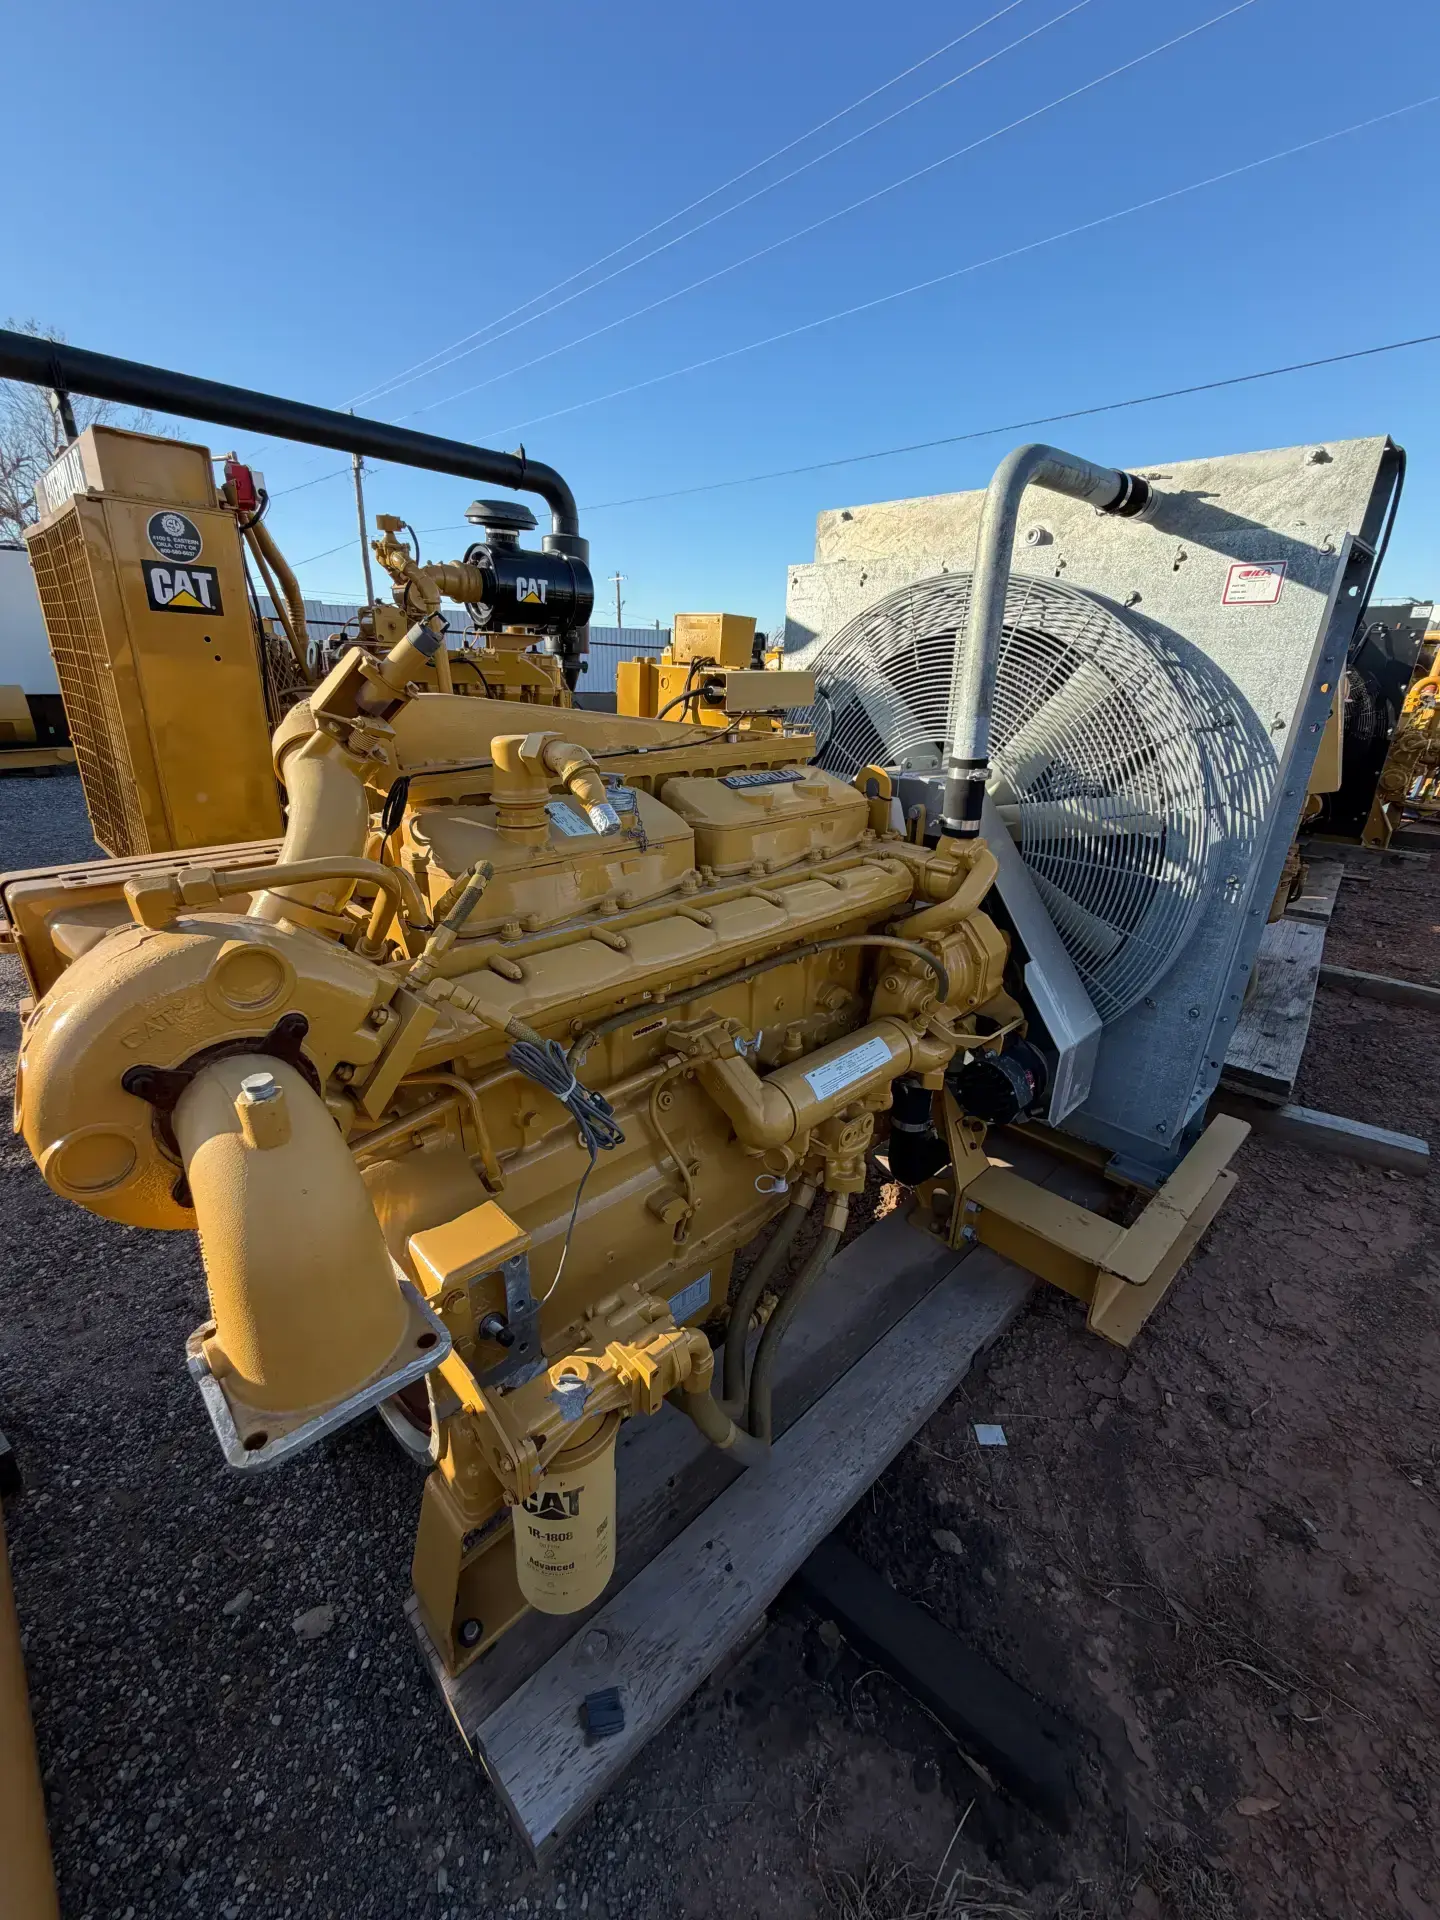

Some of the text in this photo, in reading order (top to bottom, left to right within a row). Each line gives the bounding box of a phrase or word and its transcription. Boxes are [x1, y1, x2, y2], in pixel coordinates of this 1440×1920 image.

[173, 537, 199, 545] EASTERN
[150, 568, 213, 609] CAT
[516, 576, 548, 604] CAT
[726, 770, 802, 786] CATERPILLAR
[521, 1486, 585, 1517] CAT
[527, 1526, 574, 1541] 1R-1808
[529, 1556, 575, 1571] Advanced
